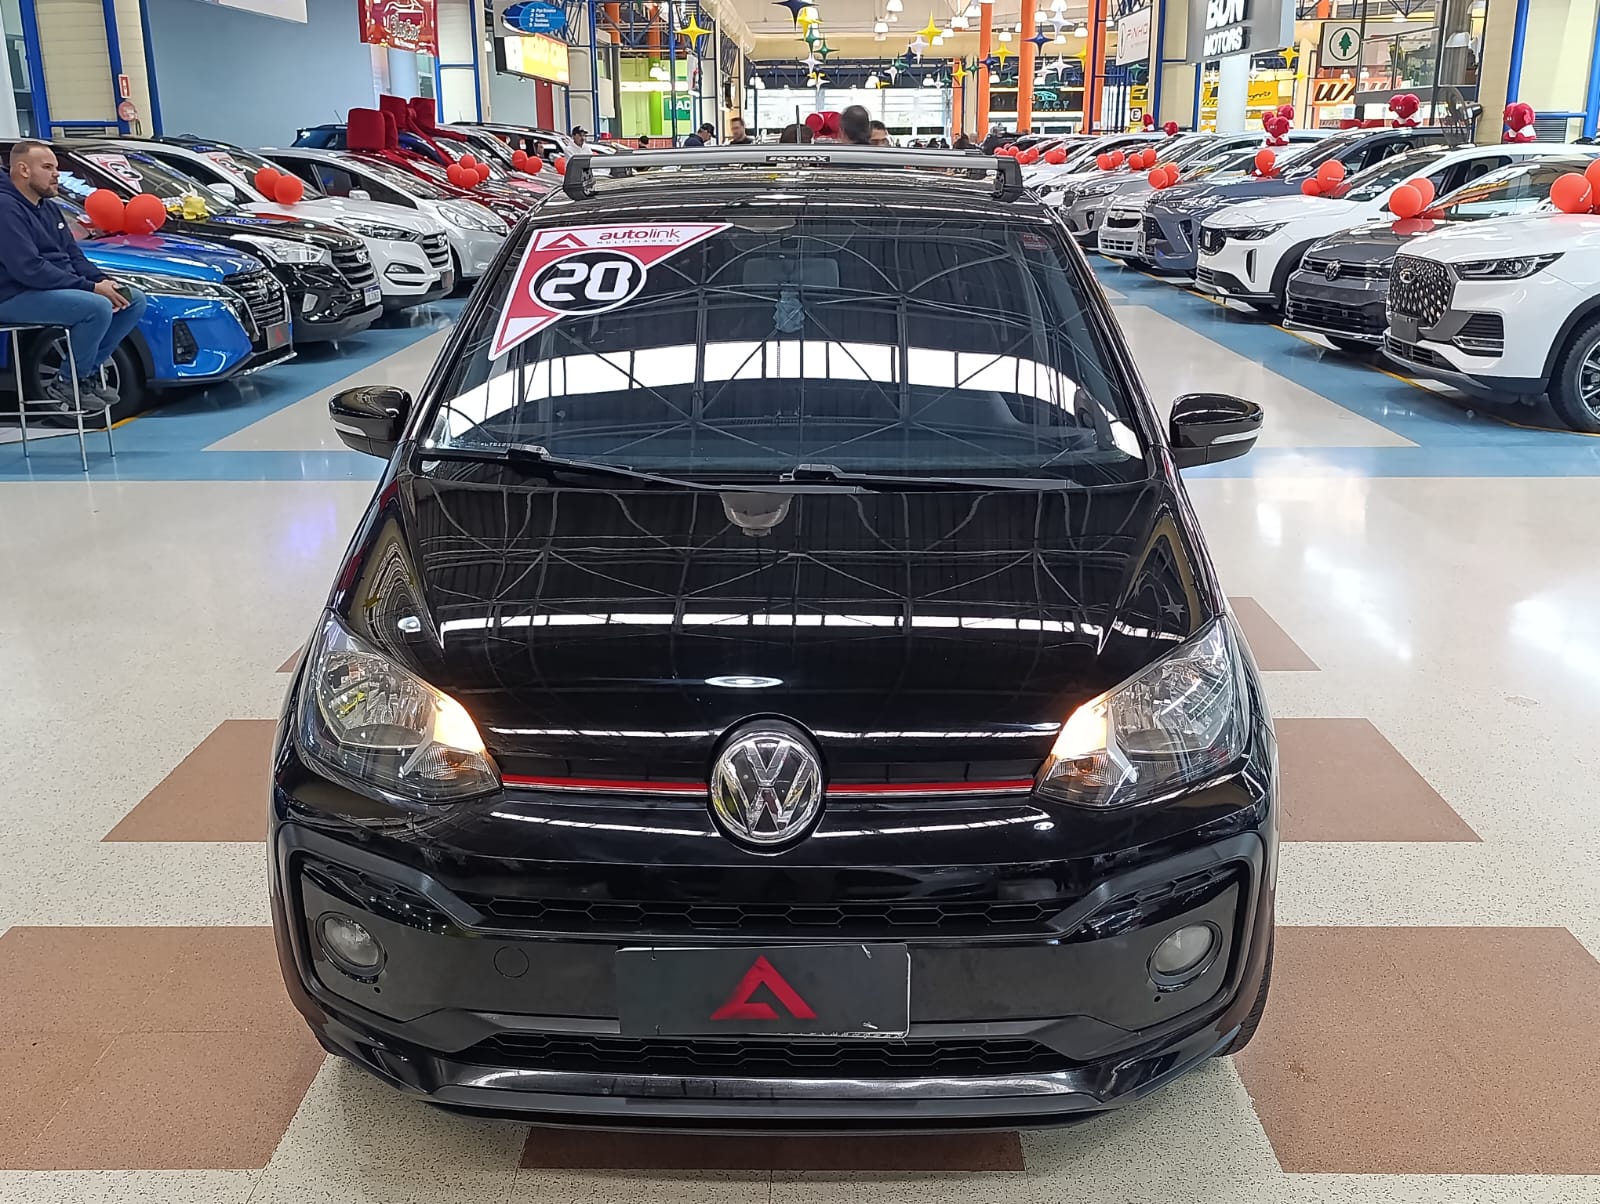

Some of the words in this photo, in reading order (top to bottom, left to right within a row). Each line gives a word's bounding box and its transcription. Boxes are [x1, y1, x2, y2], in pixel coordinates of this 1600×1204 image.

[1203, 26, 1242, 57] MOTORS
[599, 228, 680, 240] autolink
[540, 261, 633, 302] 20
